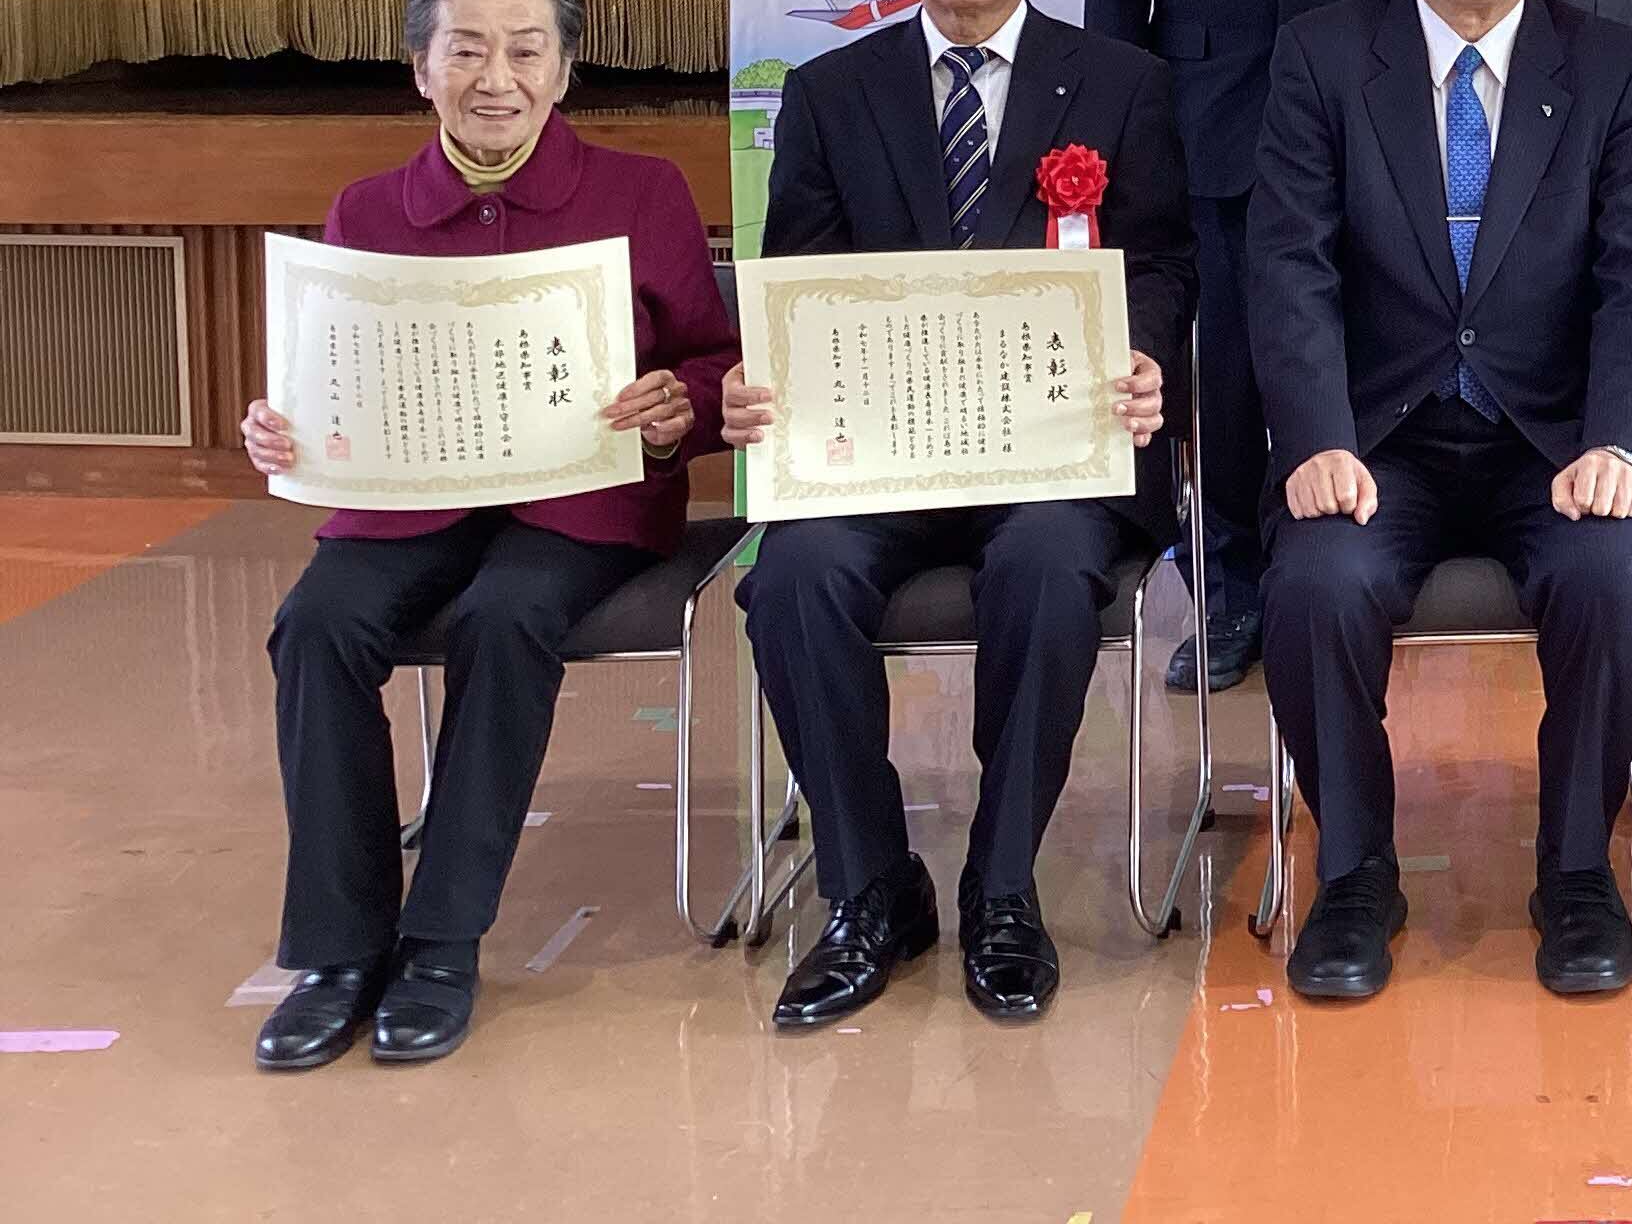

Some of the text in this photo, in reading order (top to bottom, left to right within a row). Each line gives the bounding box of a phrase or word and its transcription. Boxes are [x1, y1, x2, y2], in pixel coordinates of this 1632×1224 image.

[546, 336, 572, 407] 表彰状
[1047, 331, 1070, 402] 表彰状
